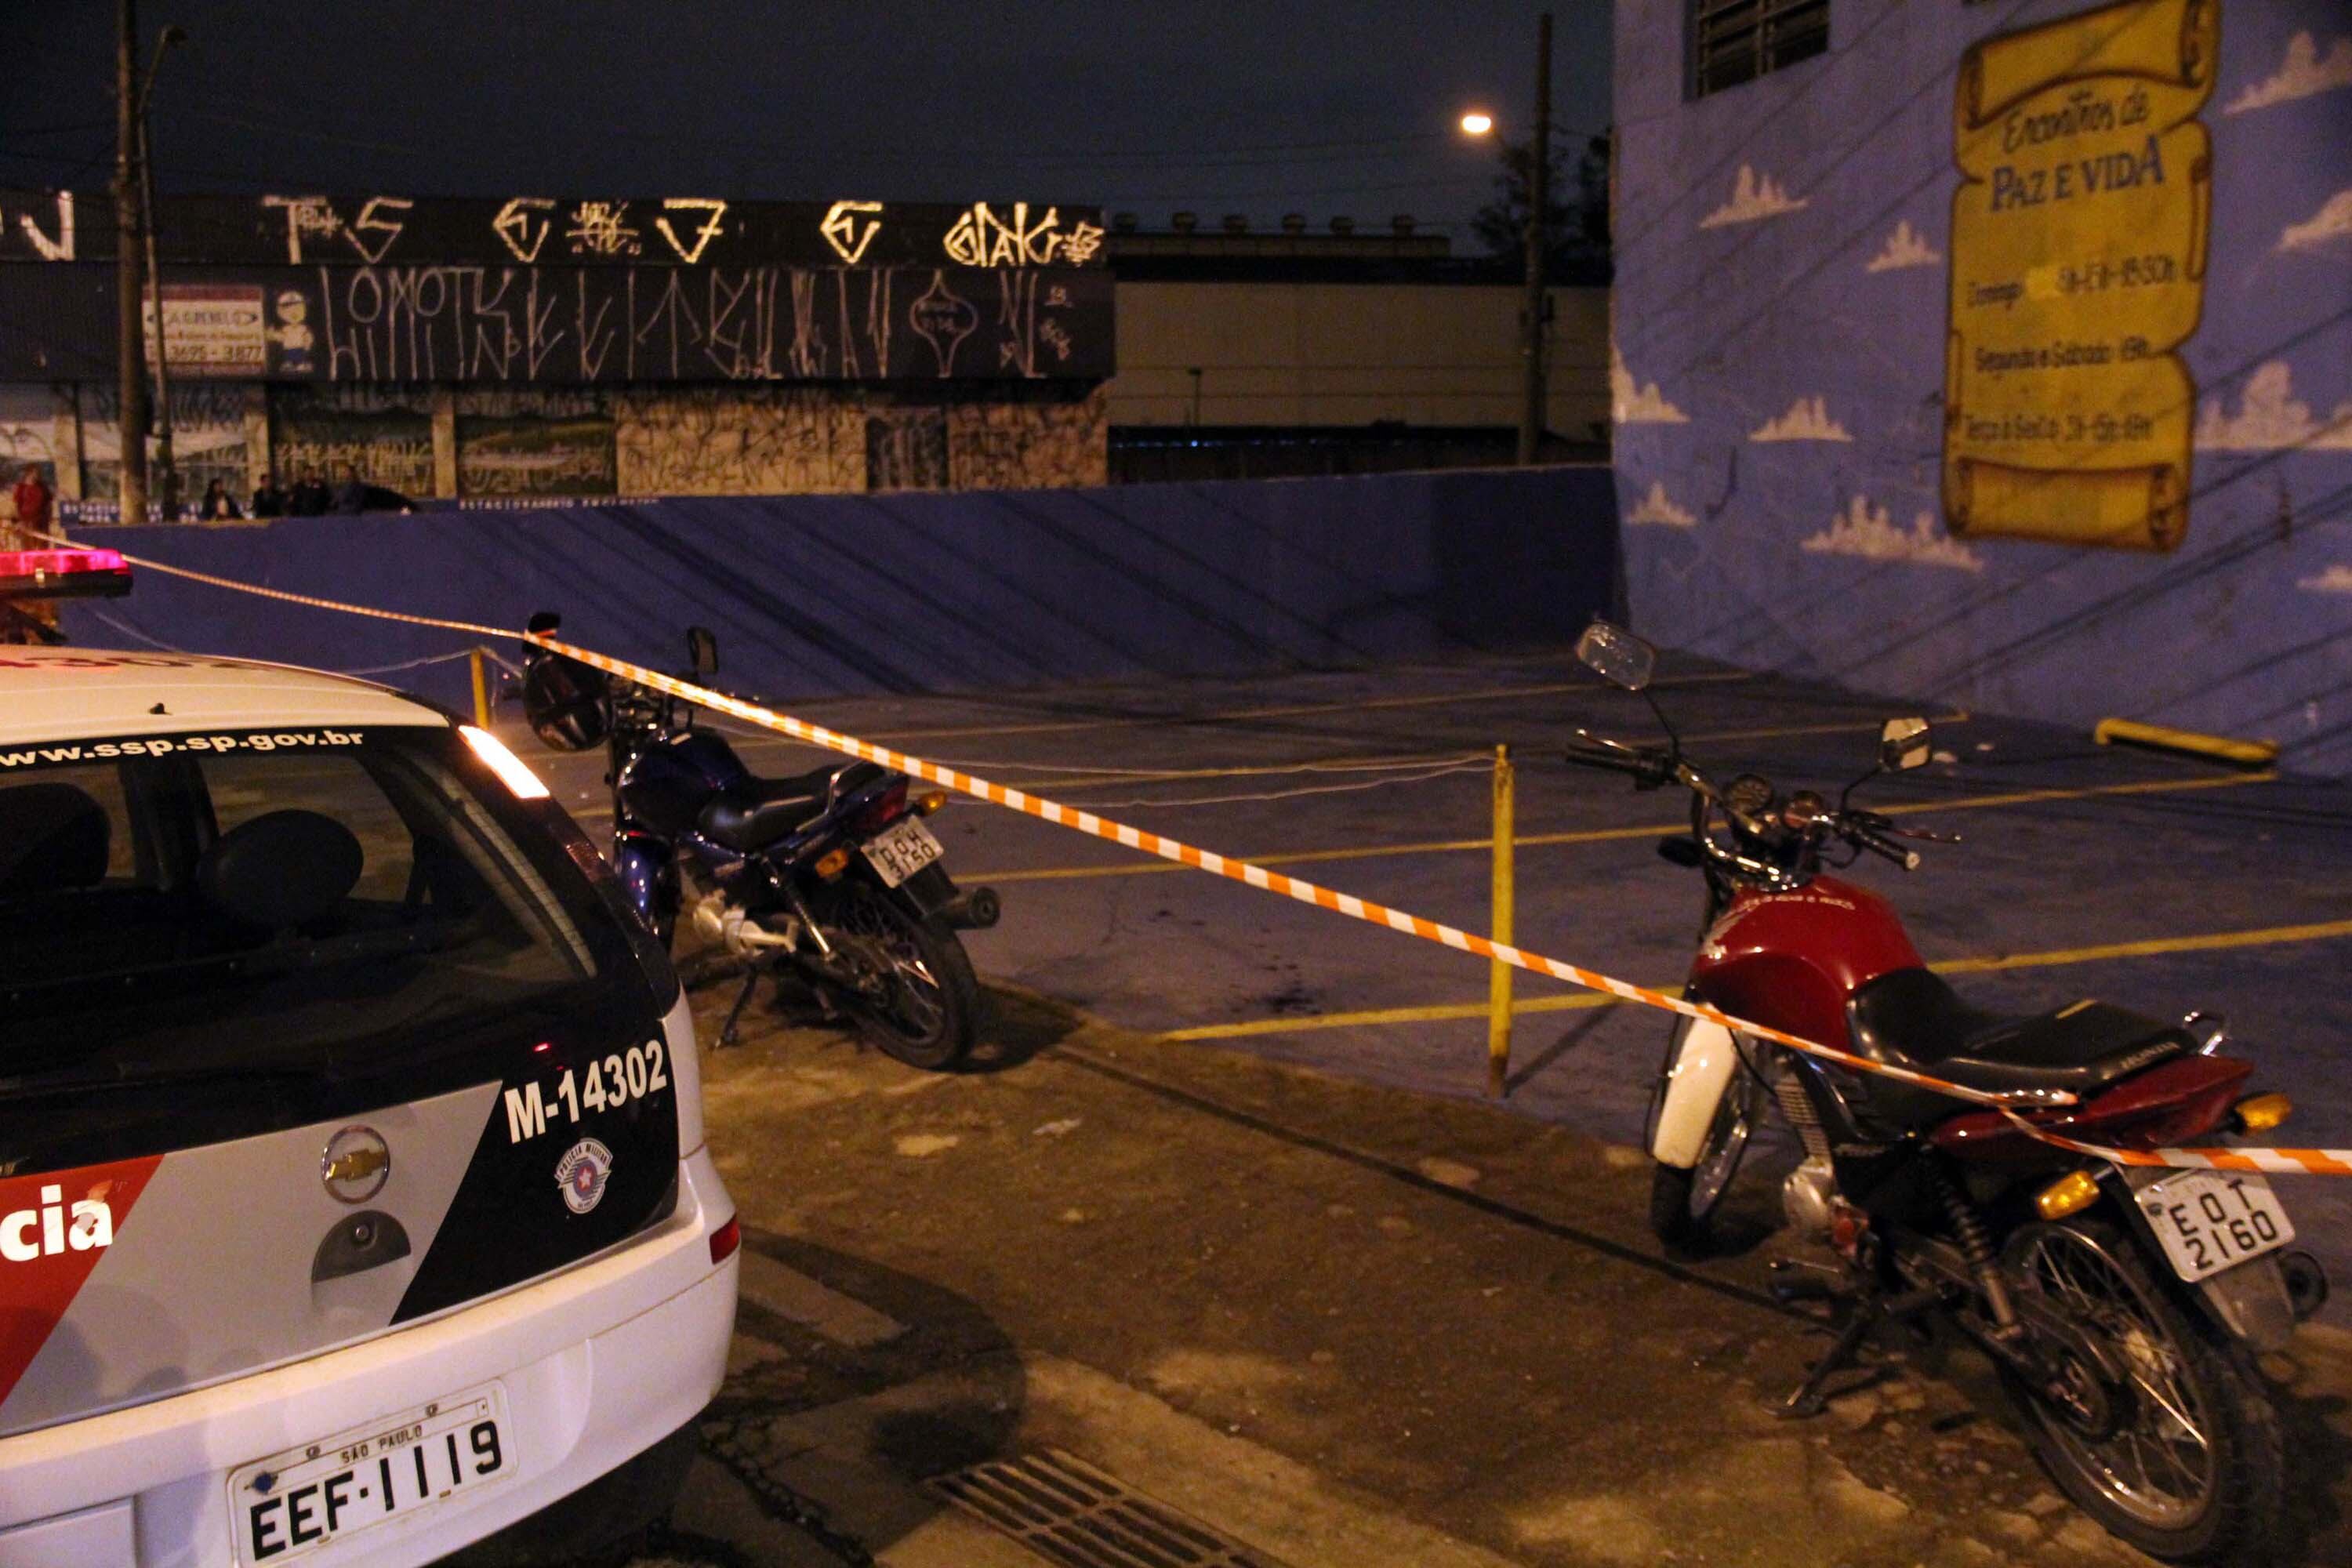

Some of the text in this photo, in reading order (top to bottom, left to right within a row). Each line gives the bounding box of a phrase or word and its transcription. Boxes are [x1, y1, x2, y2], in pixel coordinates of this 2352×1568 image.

[1991, 131, 2164, 212] PAZ E VIDA
[504, 1040, 667, 1145] M-14302
[0, 1184, 113, 1262] cia
[2184, 1210, 2278, 1270] 2160
[379, 1425, 423, 1450] PAULO
